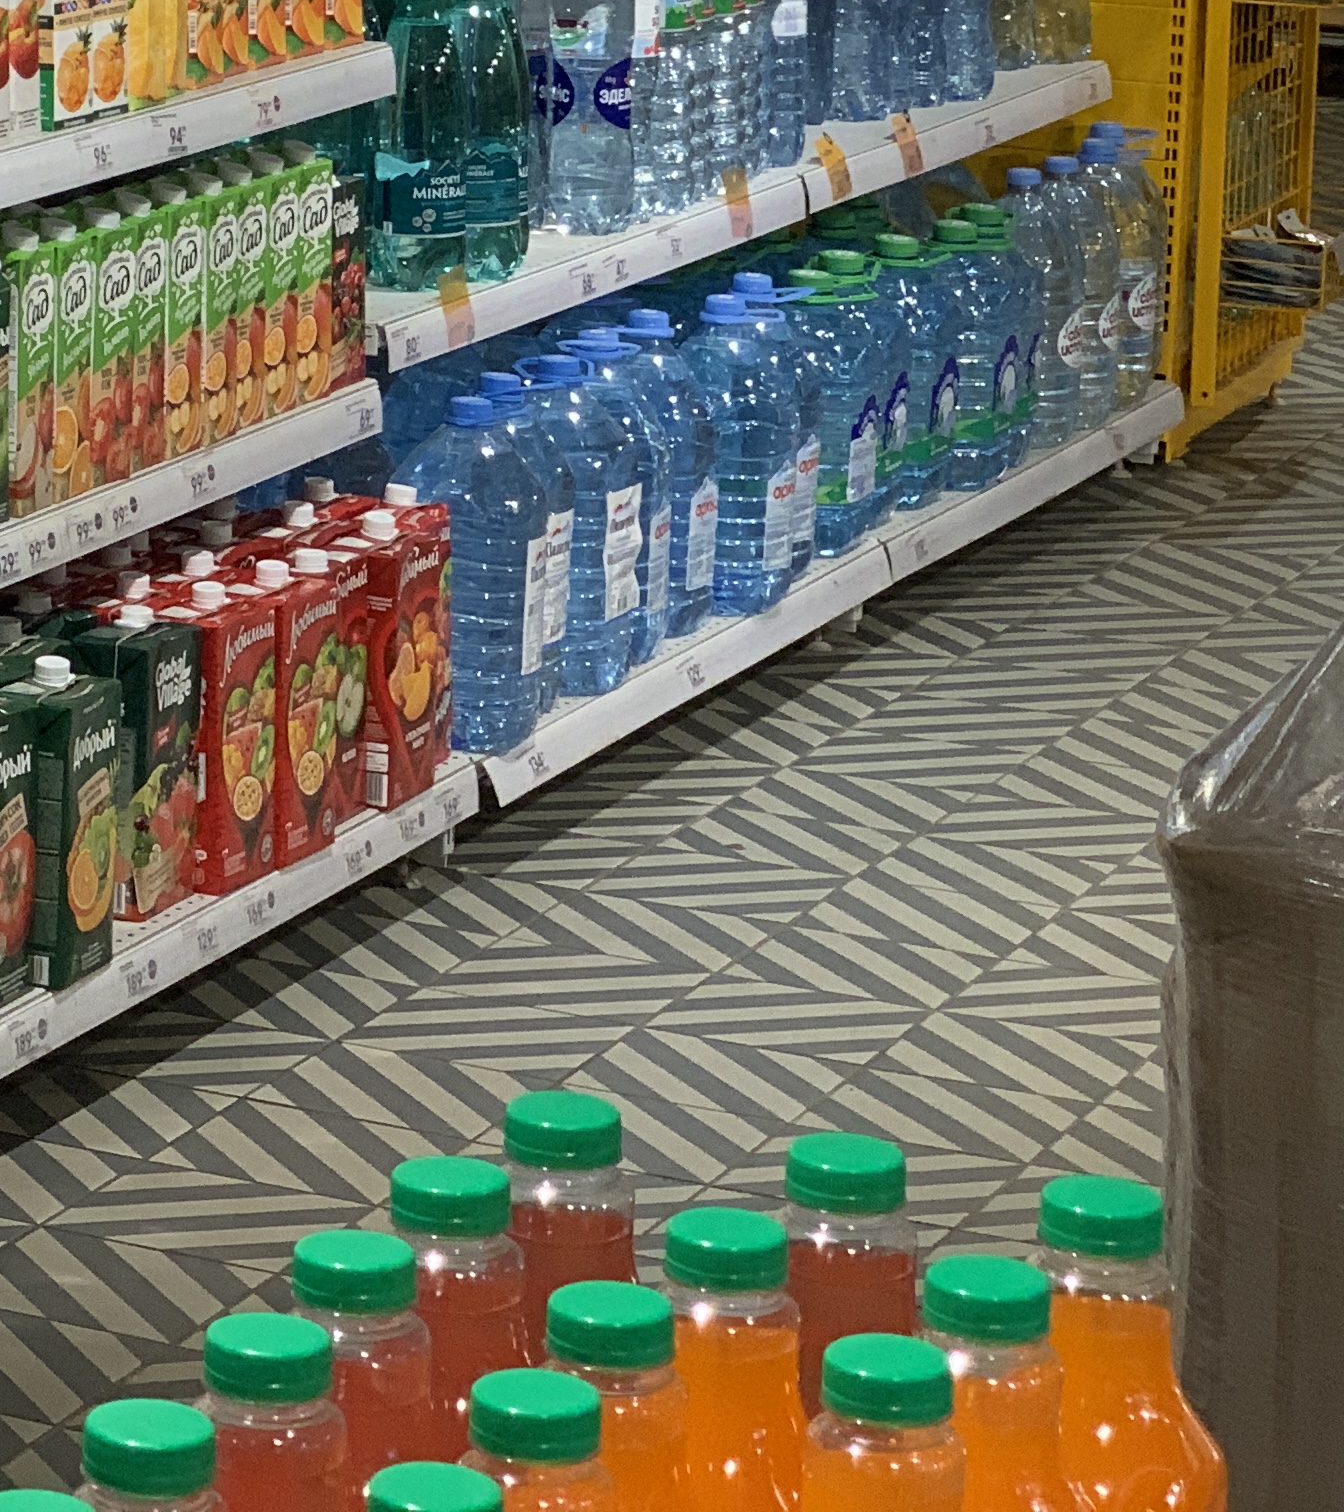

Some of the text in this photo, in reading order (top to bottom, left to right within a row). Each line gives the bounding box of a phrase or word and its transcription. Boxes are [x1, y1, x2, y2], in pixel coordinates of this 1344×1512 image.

[169, 128, 182, 145] 94
[303, 194, 329, 230] Сад
[23, 290, 49, 330] Сад
[29, 541, 44, 562] 99
[73, 718, 116, 771] Добрый
